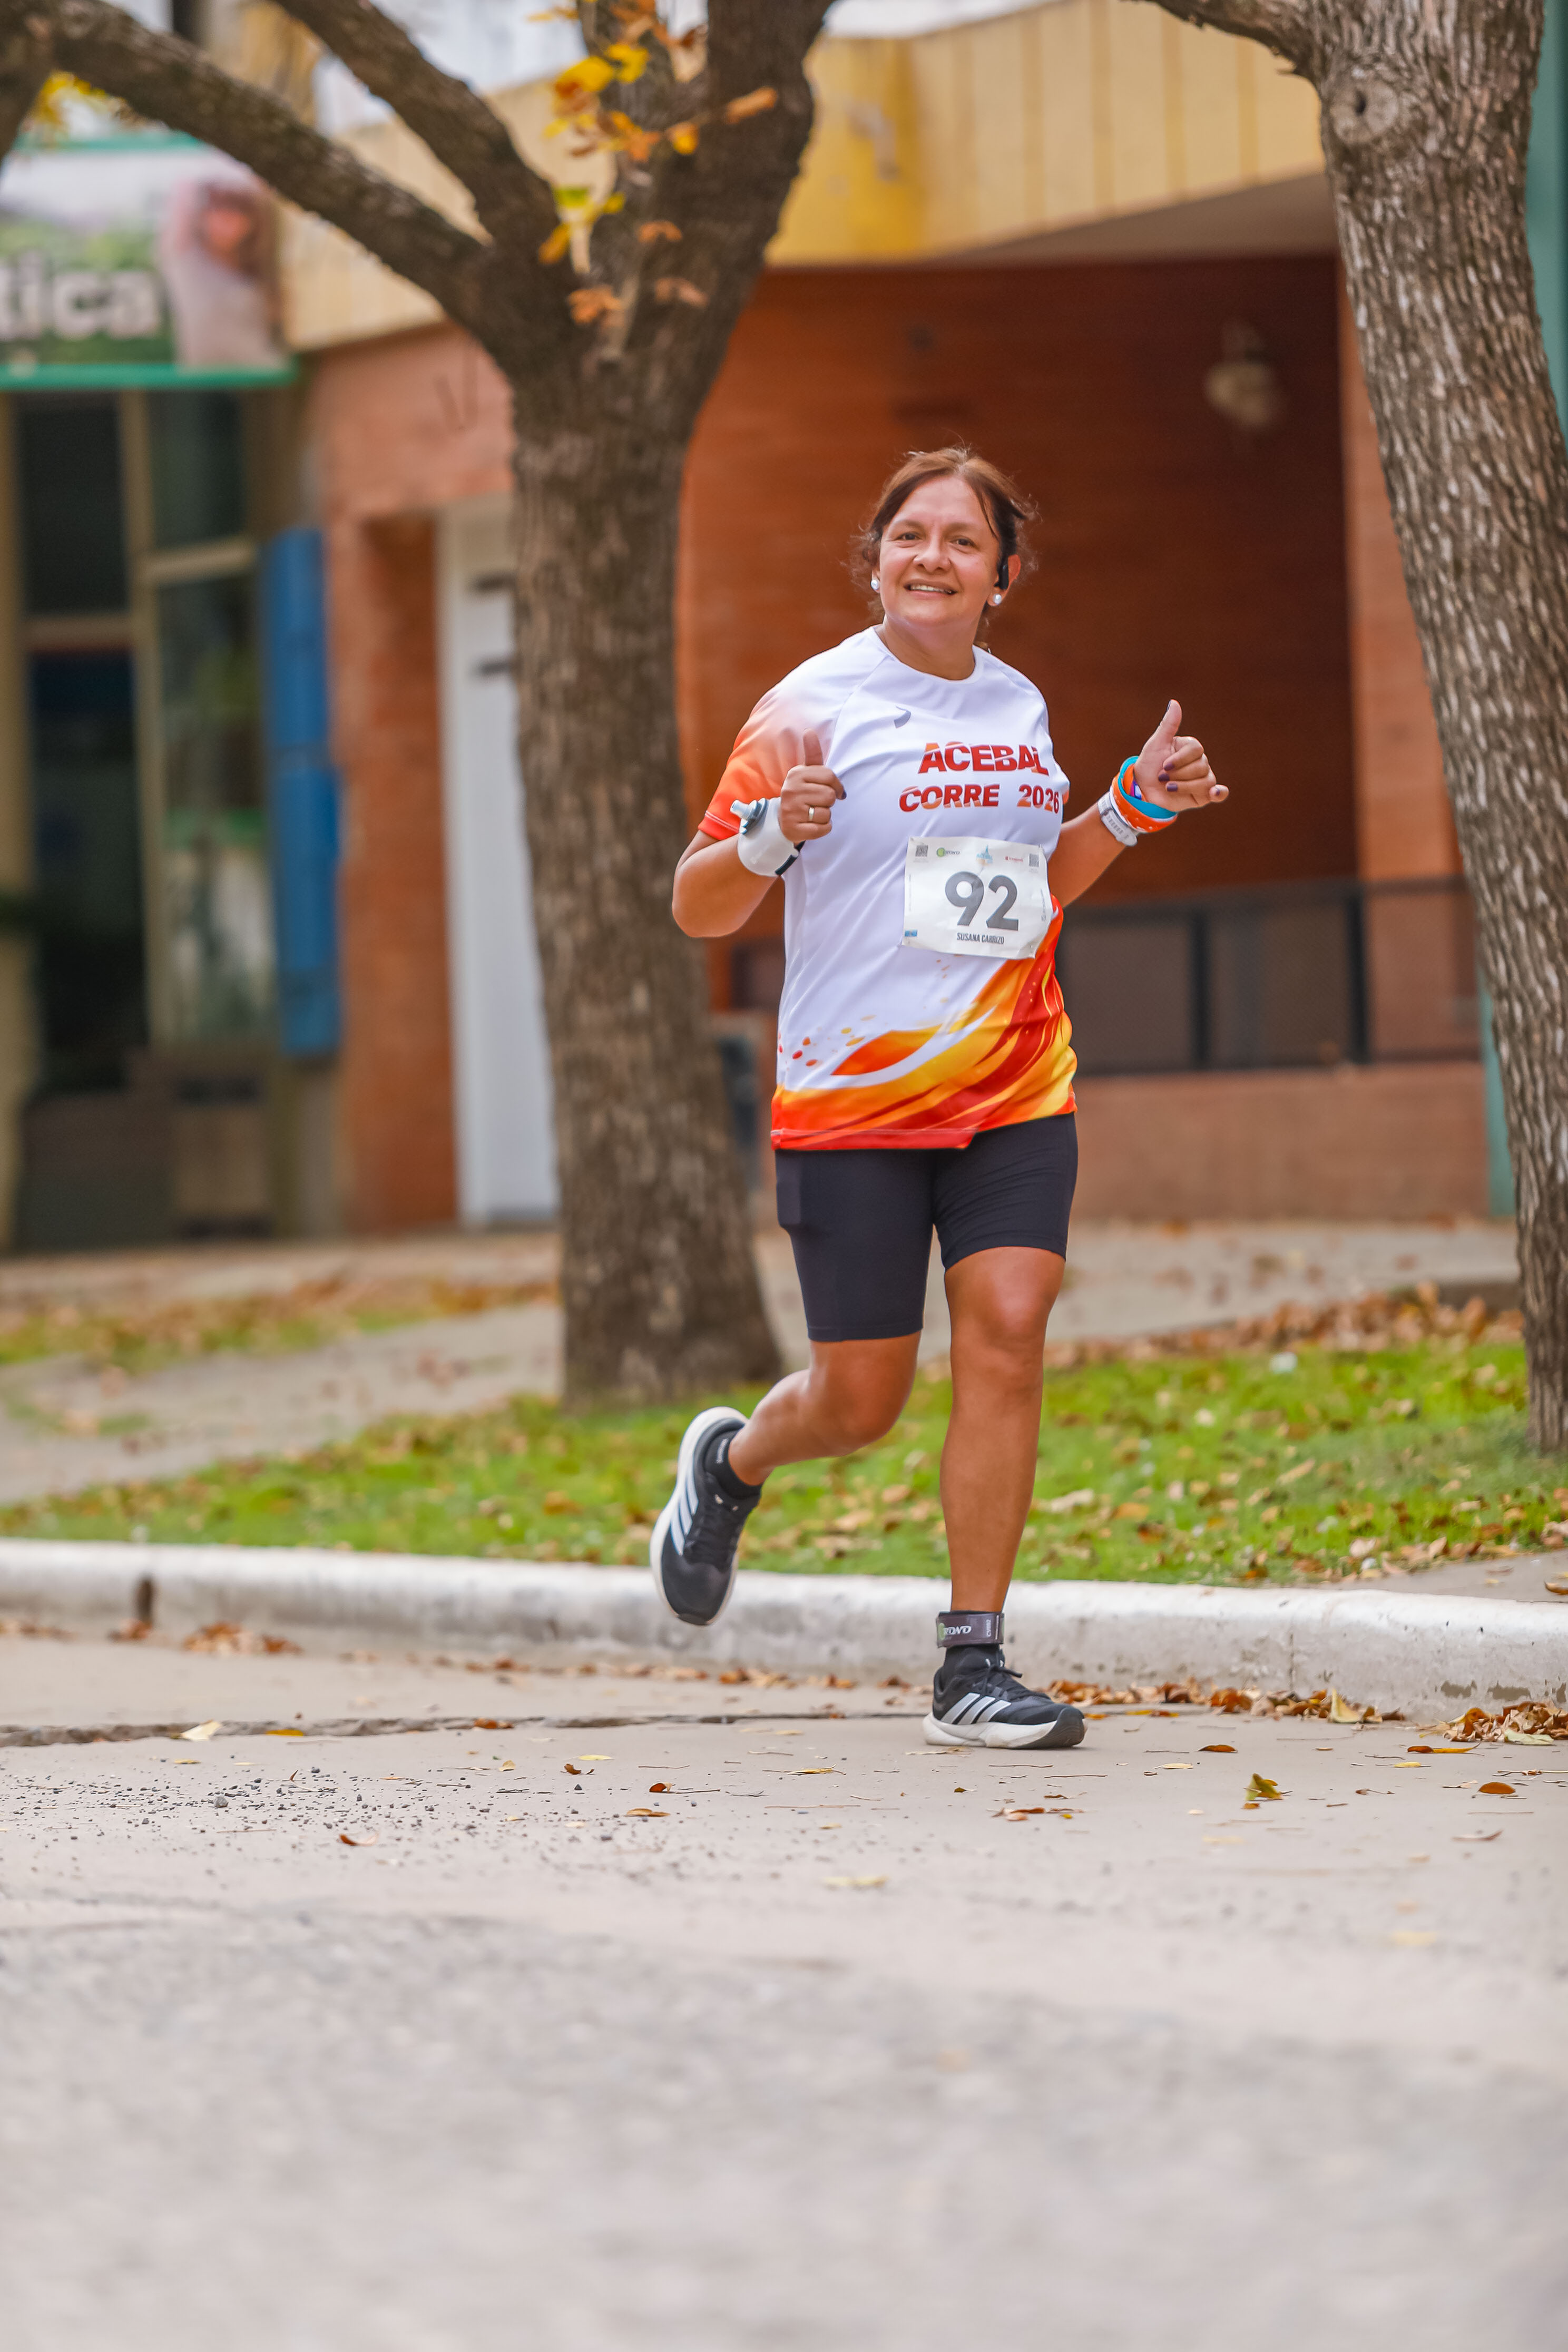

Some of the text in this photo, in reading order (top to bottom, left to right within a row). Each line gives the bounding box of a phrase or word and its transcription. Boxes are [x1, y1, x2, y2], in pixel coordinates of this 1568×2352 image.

[918, 741, 1049, 776] ACEBAL
[899, 783, 1059, 814] CORRE 2026
[945, 871, 1018, 931] 92
[956, 932, 1004, 945] SUSANA CARRIZO
